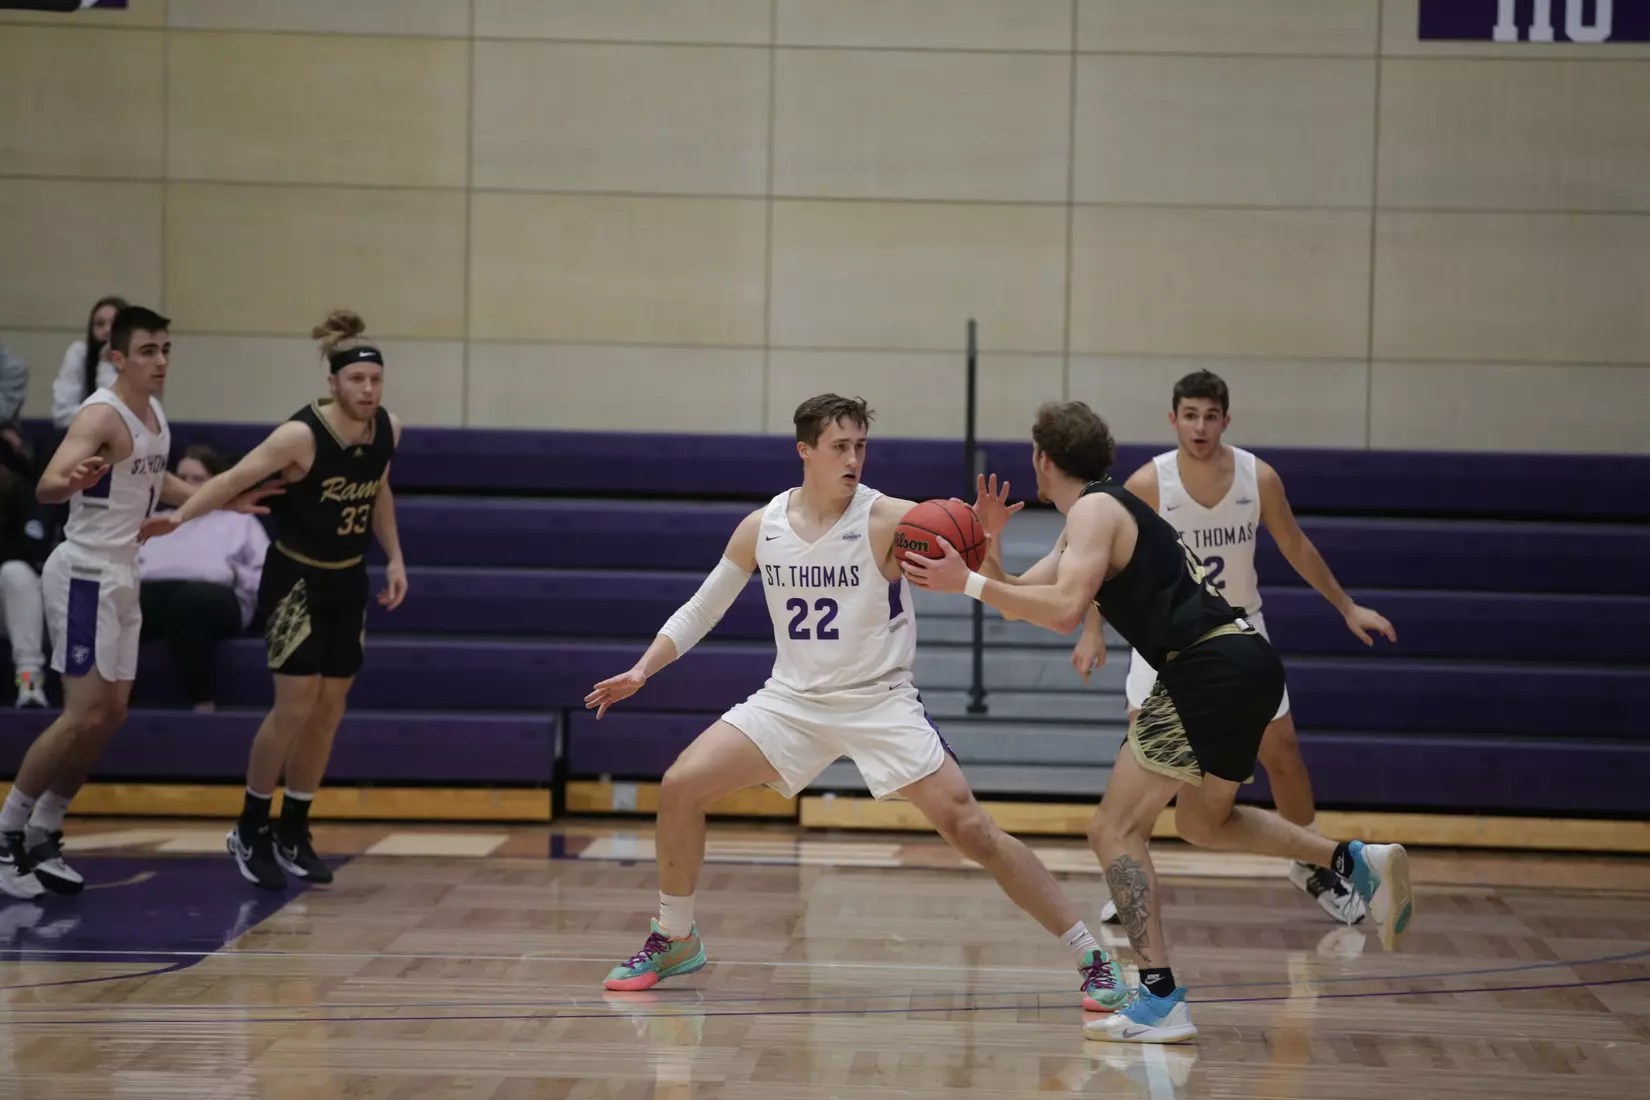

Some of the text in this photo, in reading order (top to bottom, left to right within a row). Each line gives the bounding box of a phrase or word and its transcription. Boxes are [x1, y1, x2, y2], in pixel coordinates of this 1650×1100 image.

[337, 504, 370, 535] 33
[895, 531, 929, 553] ilson
[1192, 522, 1253, 548] THOMAS
[765, 564, 860, 588] ST. THOMAS
[786, 597, 840, 640] 22
